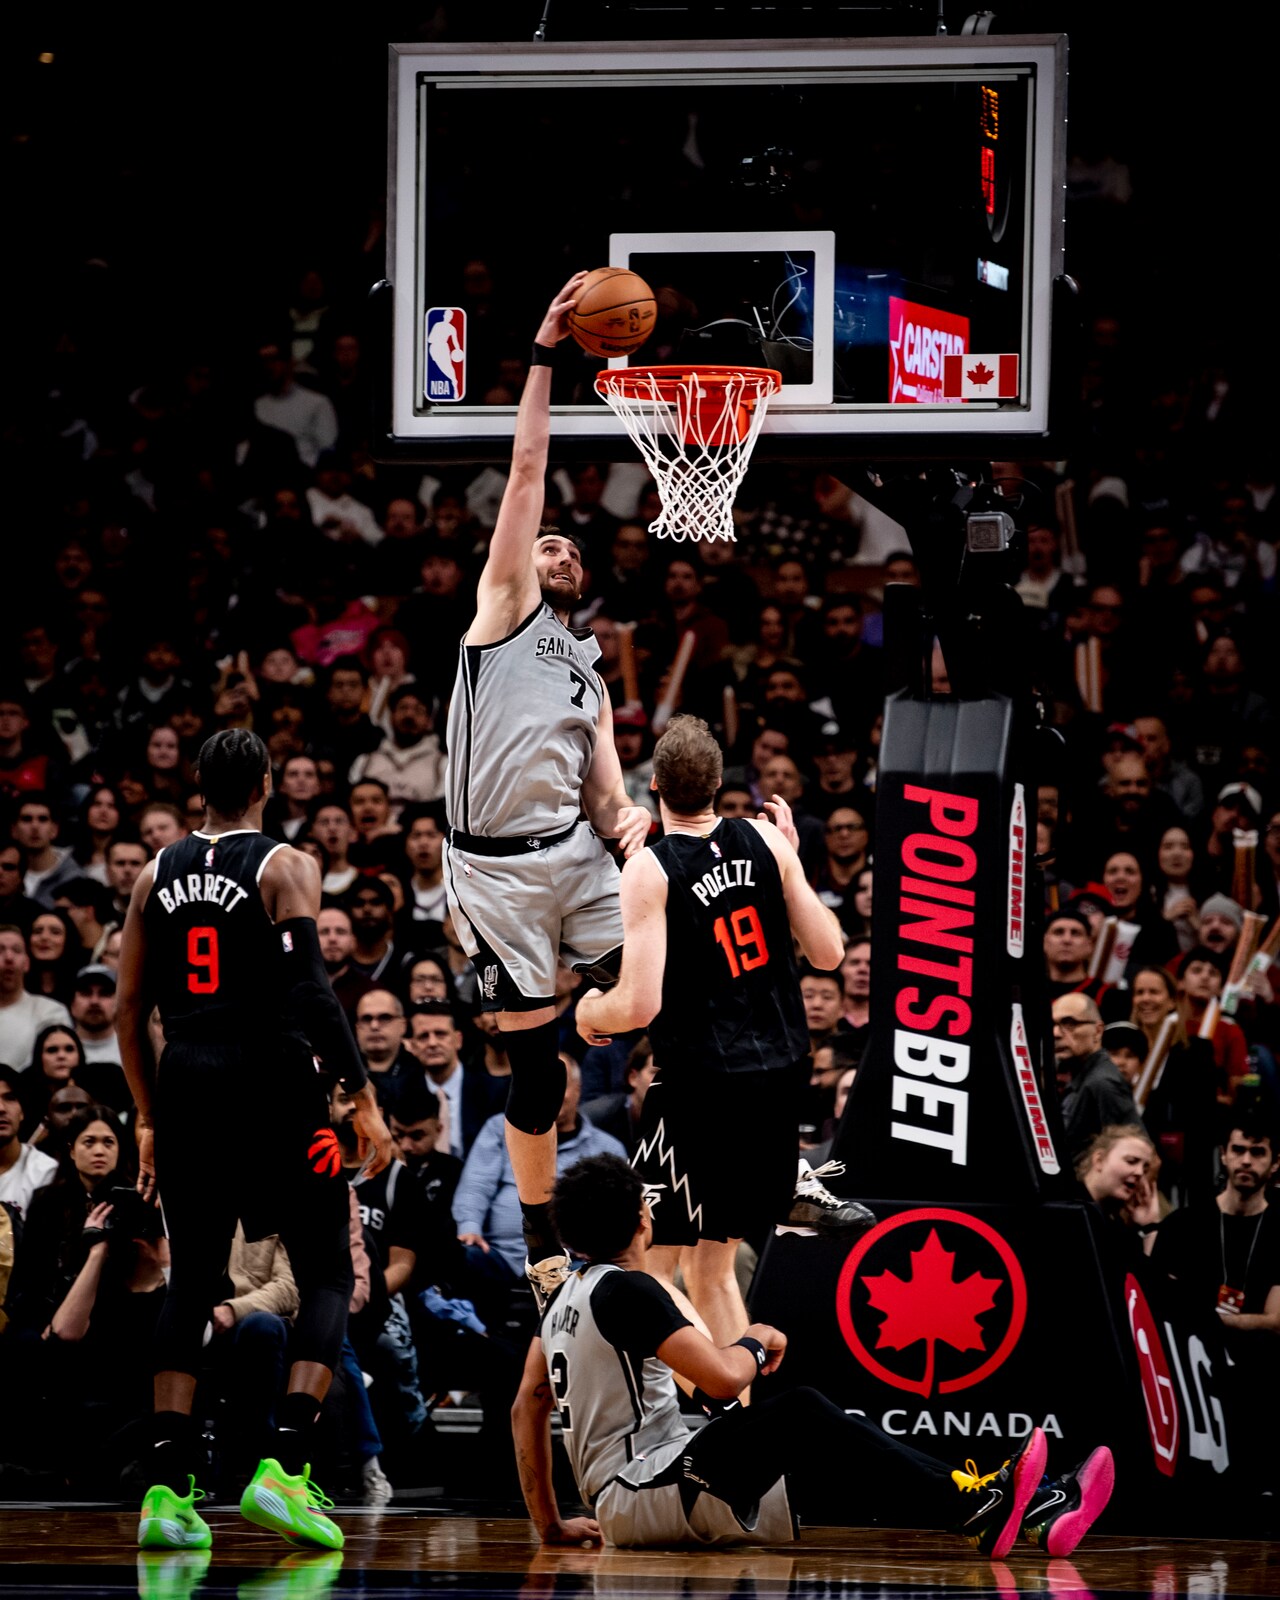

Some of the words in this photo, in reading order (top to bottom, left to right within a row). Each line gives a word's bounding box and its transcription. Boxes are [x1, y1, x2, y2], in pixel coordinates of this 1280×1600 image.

[430, 380, 450, 395] NBA
[535, 636, 565, 657] SAN
[569, 669, 586, 709] 7
[157, 873, 249, 914] BARRETT
[691, 859, 756, 907] POELTL
[187, 926, 220, 994] 9
[713, 905, 769, 978] 19
[891, 784, 979, 1166] POINTSBET
[1164, 1321, 1230, 1474] LG
[881, 1409, 1064, 1439] CANADA
